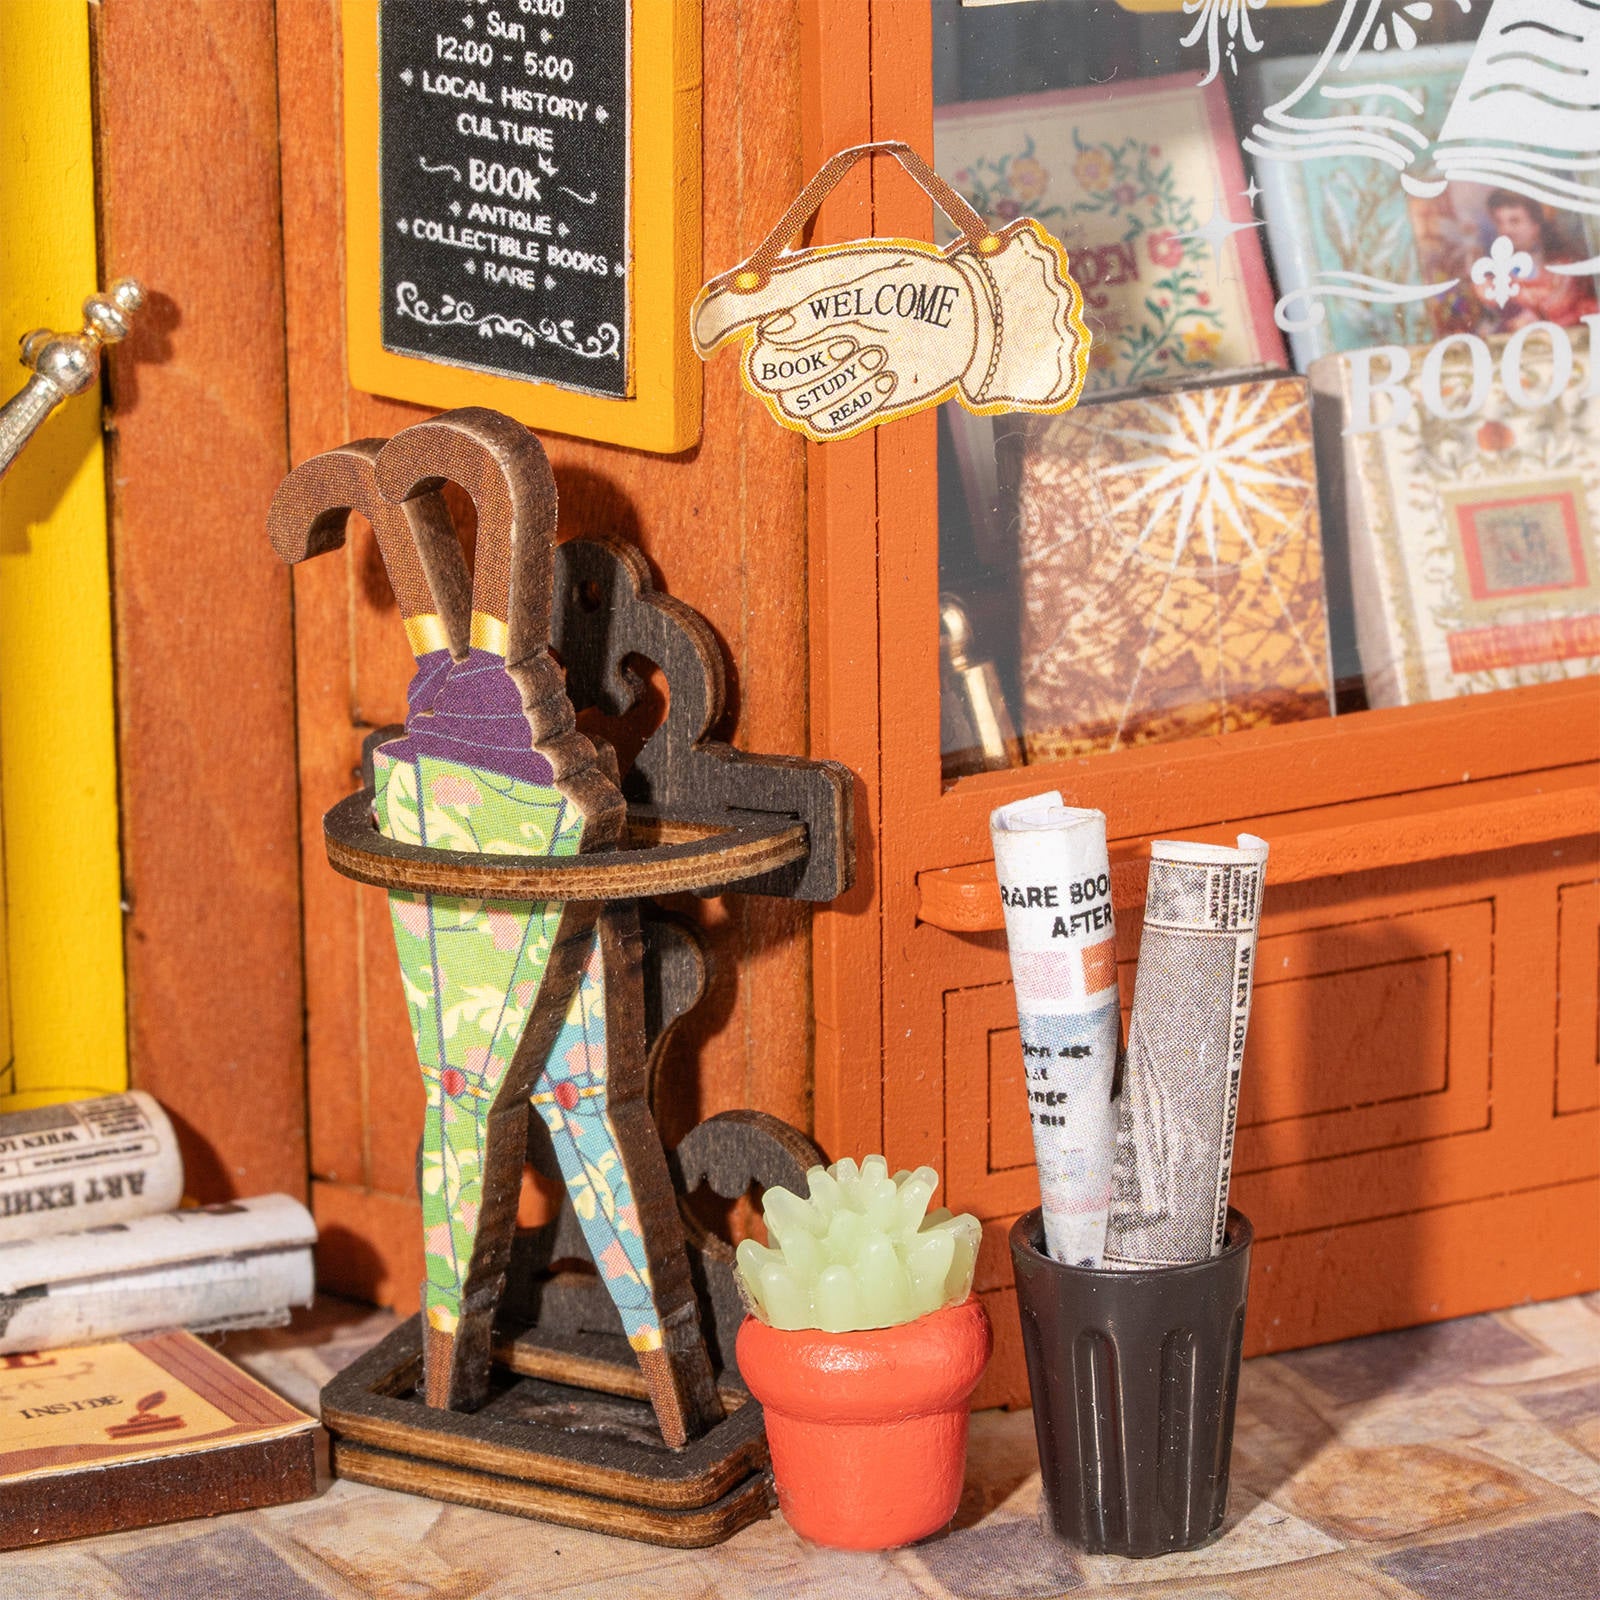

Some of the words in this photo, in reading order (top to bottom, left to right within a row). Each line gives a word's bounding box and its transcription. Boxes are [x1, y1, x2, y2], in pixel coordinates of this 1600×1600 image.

[486, 11, 525, 42] Sun
[437, 34, 493, 67] 12:00
[524, 51, 573, 82] 5:00
[422, 71, 493, 104] LOCAL
[501, 87, 588, 122] HISTORY
[457, 113, 554, 151] CULTURE
[468, 157, 541, 201] BOOK
[467, 203, 552, 236] ANTIQUE
[412, 218, 541, 263] COLLECTIBLE
[547, 245, 608, 276] BOOKS
[483, 262, 536, 291] RARE
[808, 284, 960, 329] WELCOME
[761, 351, 827, 381] BOOK
[796, 366, 858, 411] STUDY
[829, 390, 873, 425] READ
[1000, 885, 1060, 909] RARE
[1070, 873, 1111, 905] BOO
[1051, 902, 1112, 938] AFTER
[1236, 947, 1252, 1009] WHEN
[1223, 1069, 1240, 1161] BECOMES
[23, 1130, 78, 1149] WHEN
[84, 1169, 147, 1204] ART
[1214, 1166, 1230, 1246] MELODY
[19, 1393, 124, 1420] INSIDE
